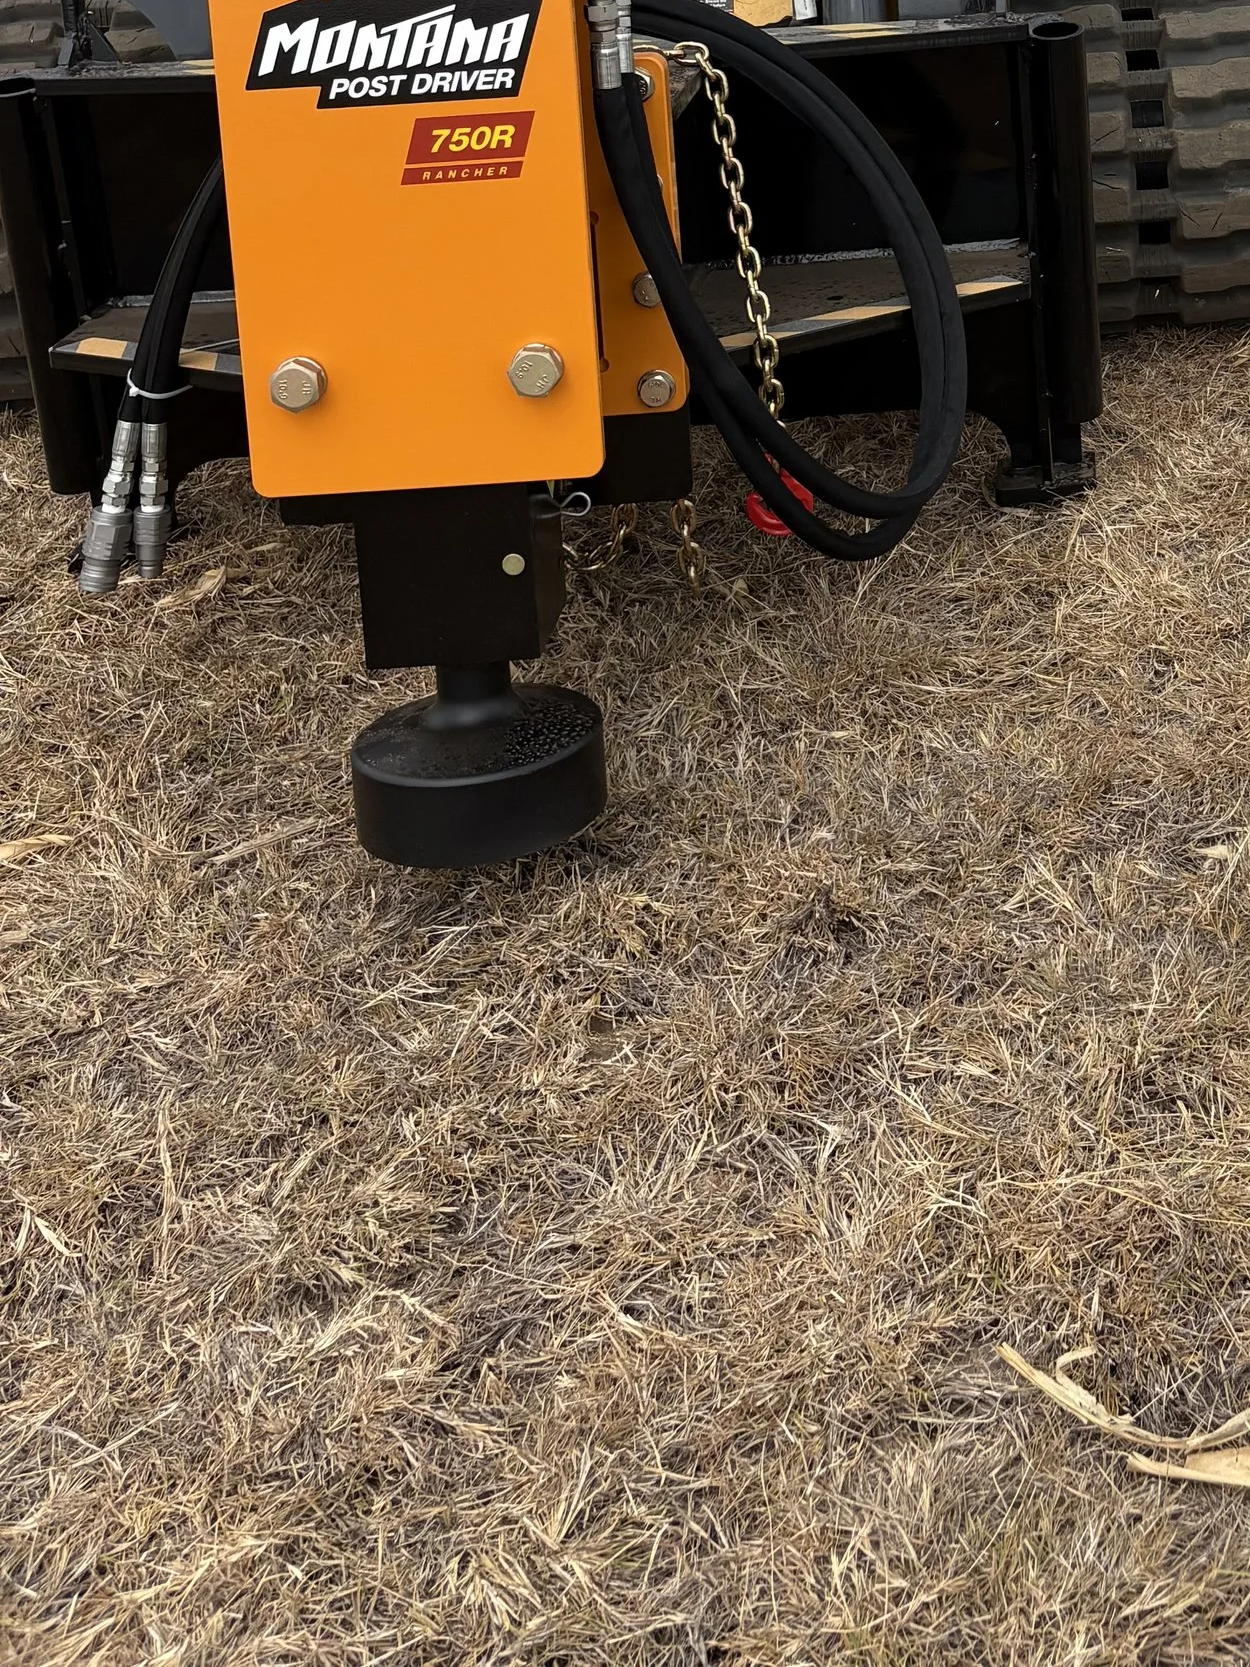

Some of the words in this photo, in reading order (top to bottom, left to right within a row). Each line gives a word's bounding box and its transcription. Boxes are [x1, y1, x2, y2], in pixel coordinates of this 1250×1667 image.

[258, 4, 530, 77] MONTANA
[329, 75, 408, 100] POST
[410, 68, 516, 95] DRIVER
[430, 124, 516, 154] 750R
[422, 166, 508, 182] RANCHER
